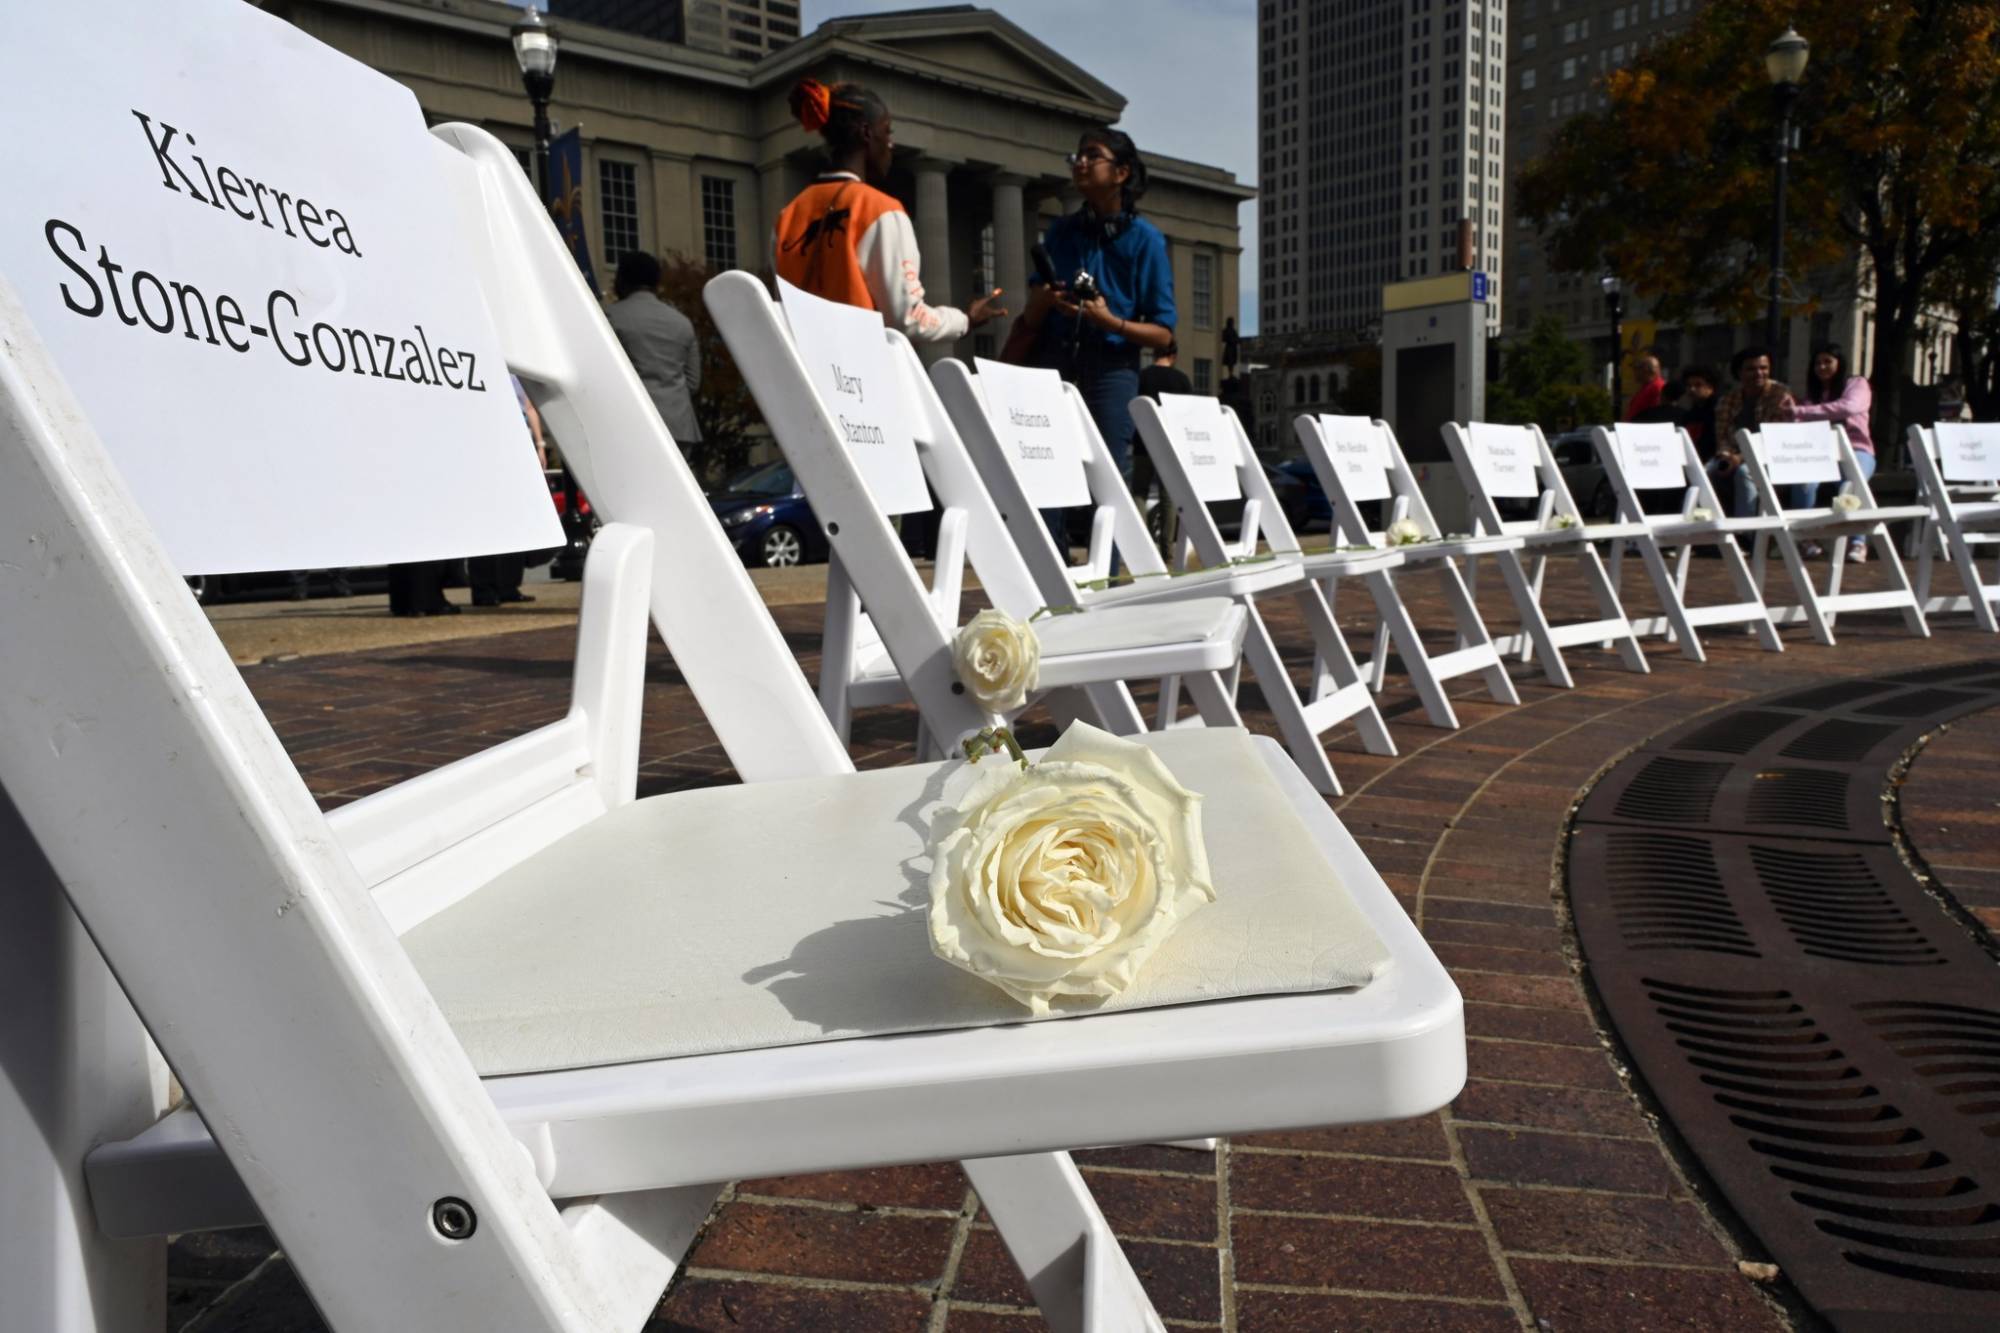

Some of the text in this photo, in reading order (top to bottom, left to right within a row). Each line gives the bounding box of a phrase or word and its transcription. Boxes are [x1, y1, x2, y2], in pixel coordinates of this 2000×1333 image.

[132, 109, 363, 258] Kierrea
[45, 218, 487, 392] Stone-Gonzalez
[831, 363, 863, 403] Mary
[839, 414, 884, 444] Stanton
